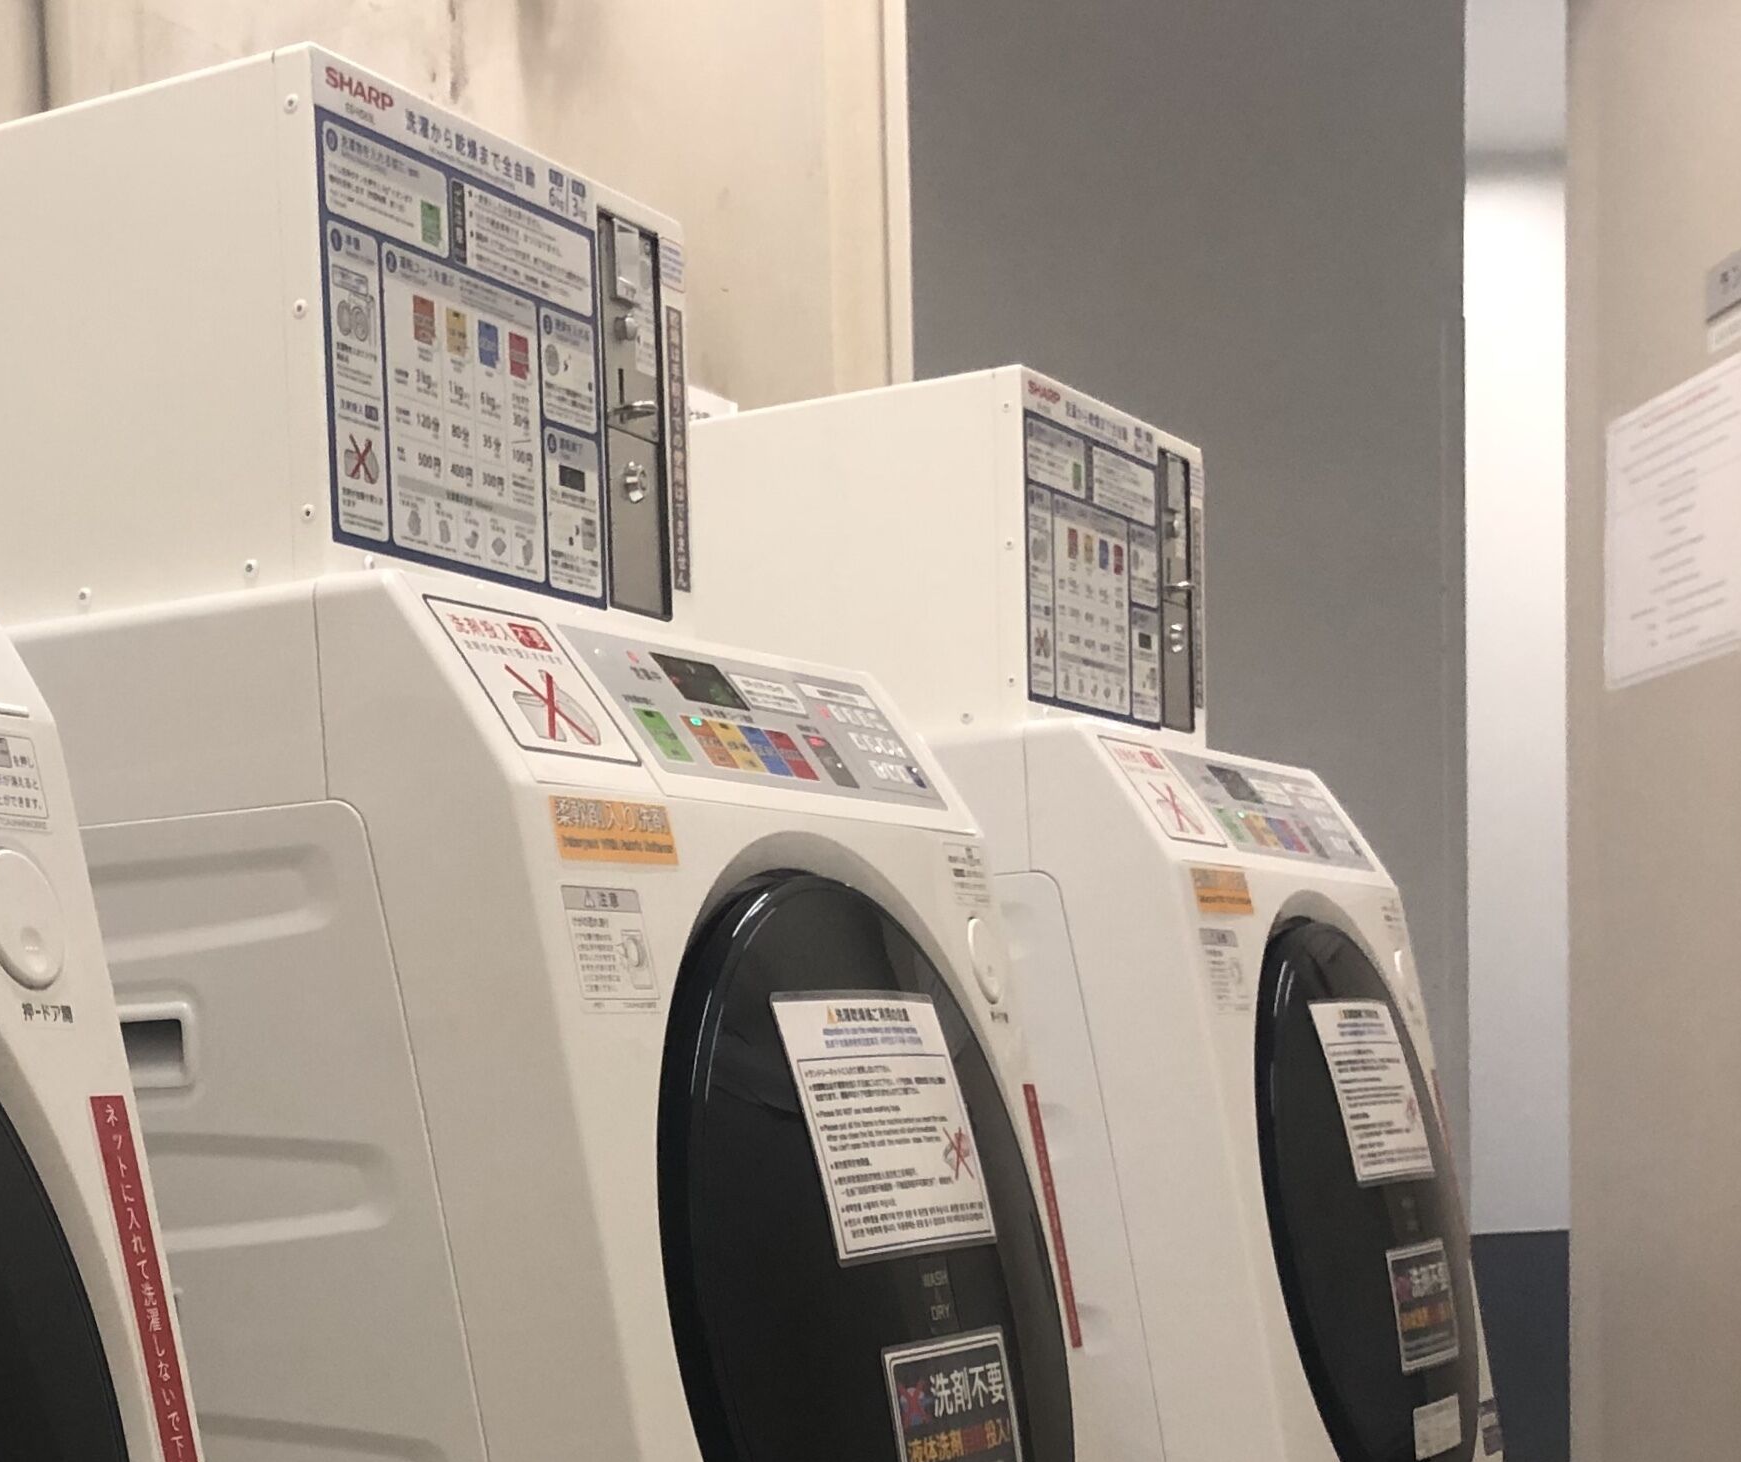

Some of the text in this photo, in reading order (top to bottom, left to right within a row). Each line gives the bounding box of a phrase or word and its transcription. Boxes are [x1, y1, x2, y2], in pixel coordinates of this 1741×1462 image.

[324, 66, 395, 111] SHARP
[930, 1304, 952, 1322] DRY
[929, 1361, 1006, 1419] 洗剤不要
